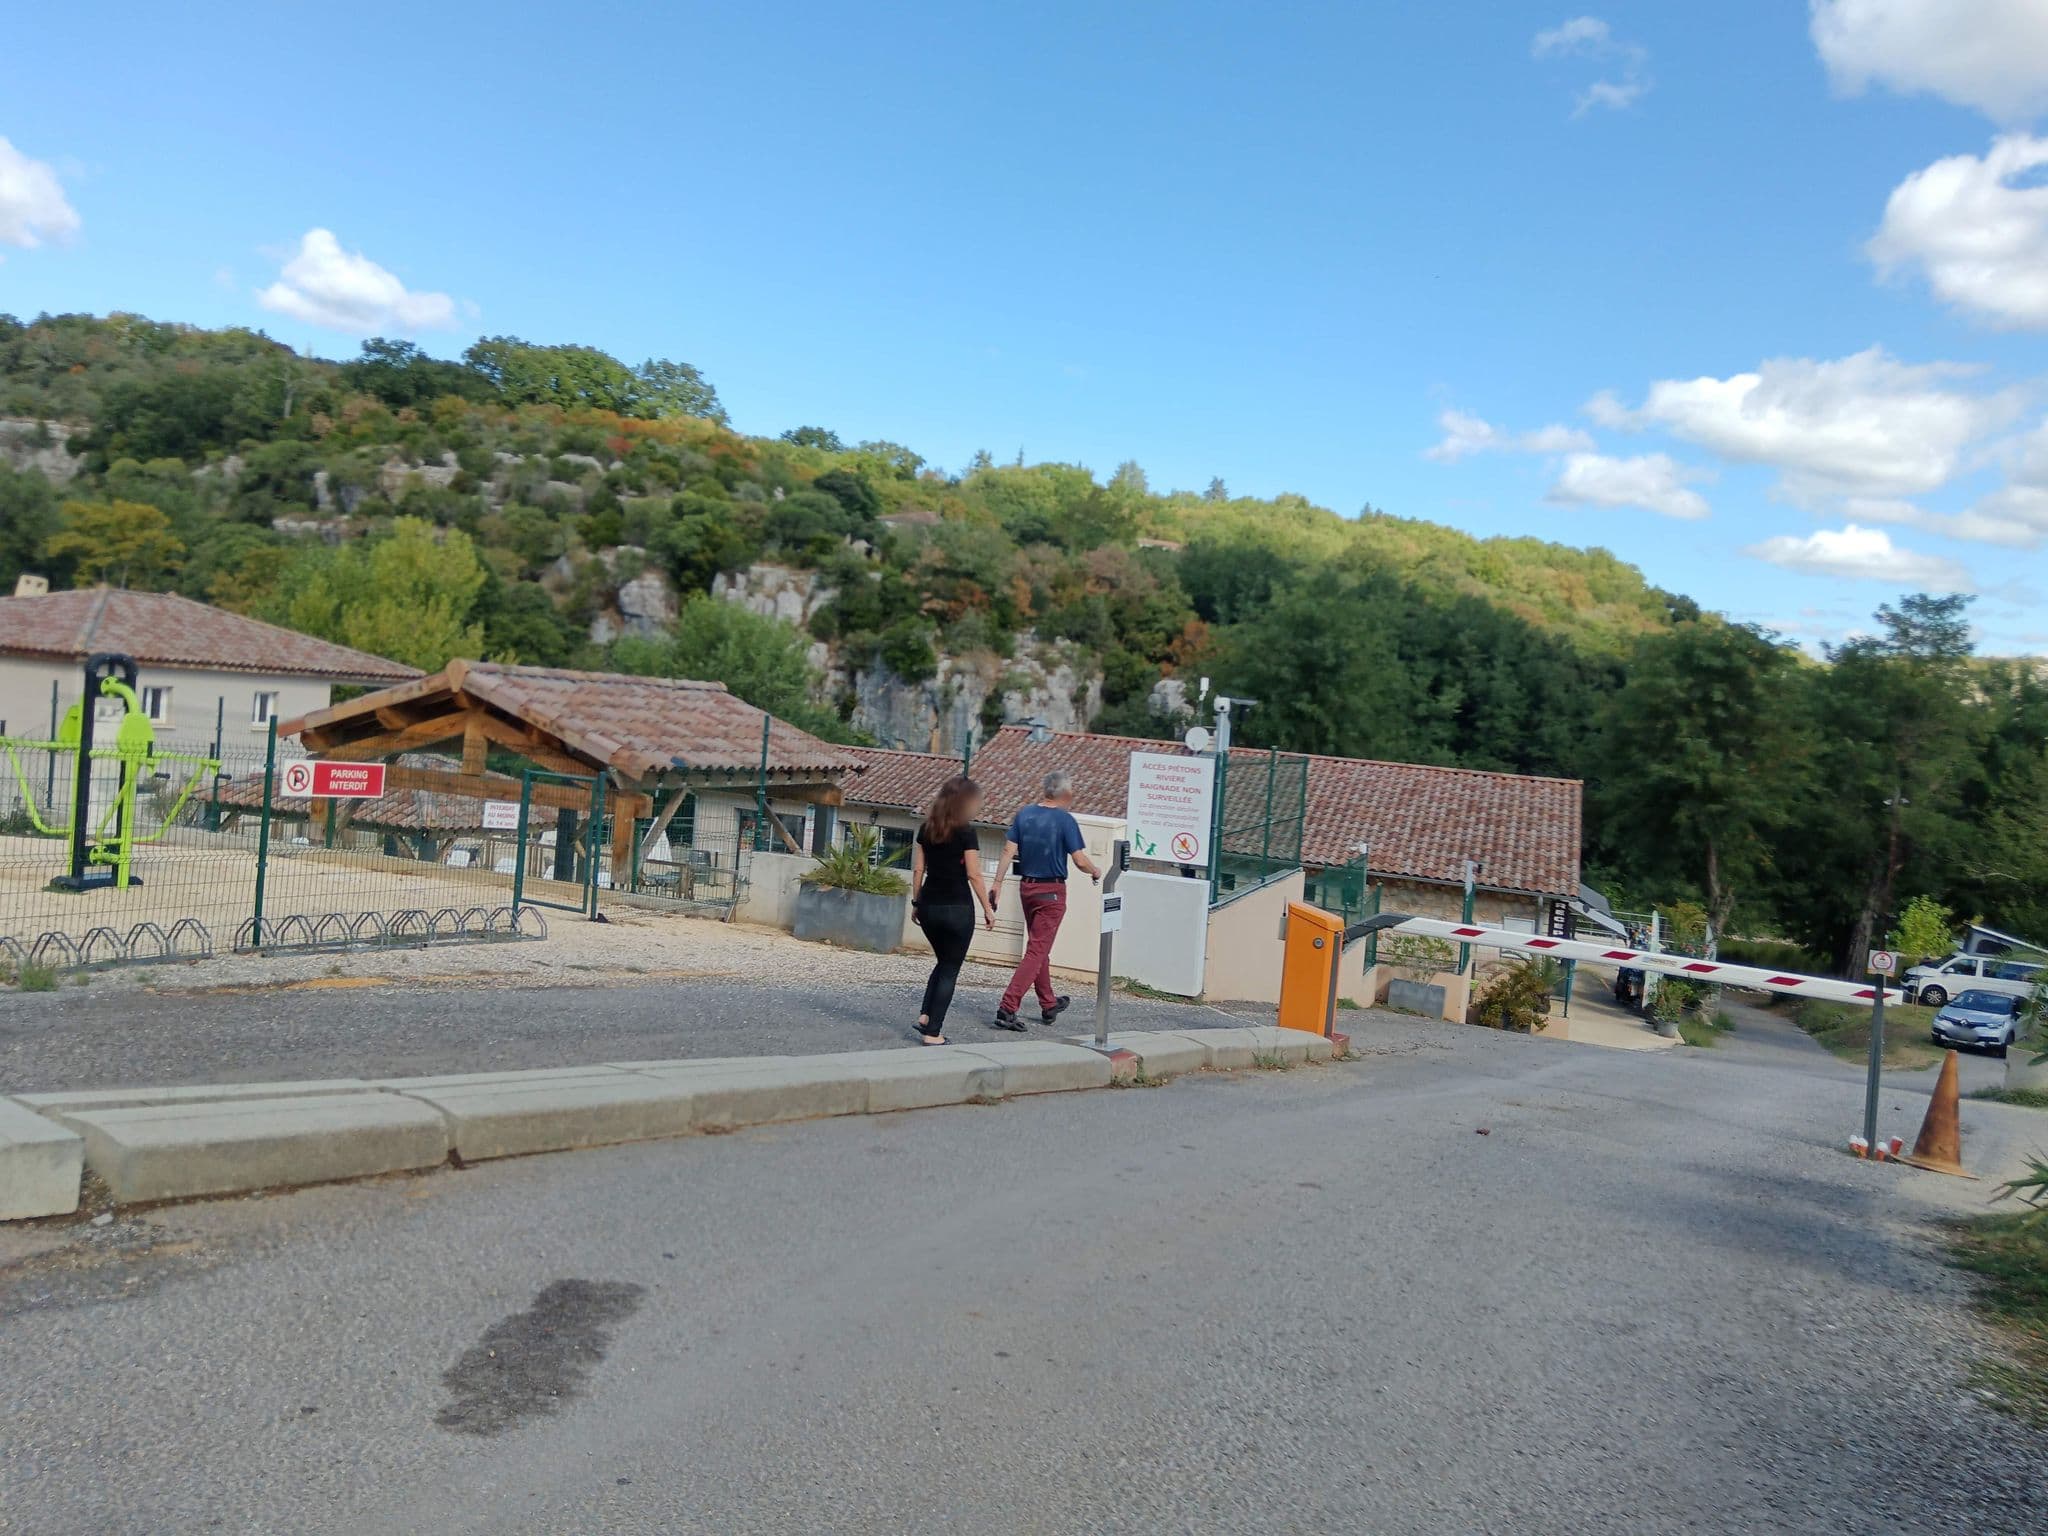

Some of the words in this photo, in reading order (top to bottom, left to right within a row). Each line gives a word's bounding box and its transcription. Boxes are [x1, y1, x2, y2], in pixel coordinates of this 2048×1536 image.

[330, 769, 368, 779] PARKING
[329, 781, 368, 791] INTERDIT
[1139, 782, 1181, 793] BAIGNADE
[1182, 786, 1201, 795] NON
